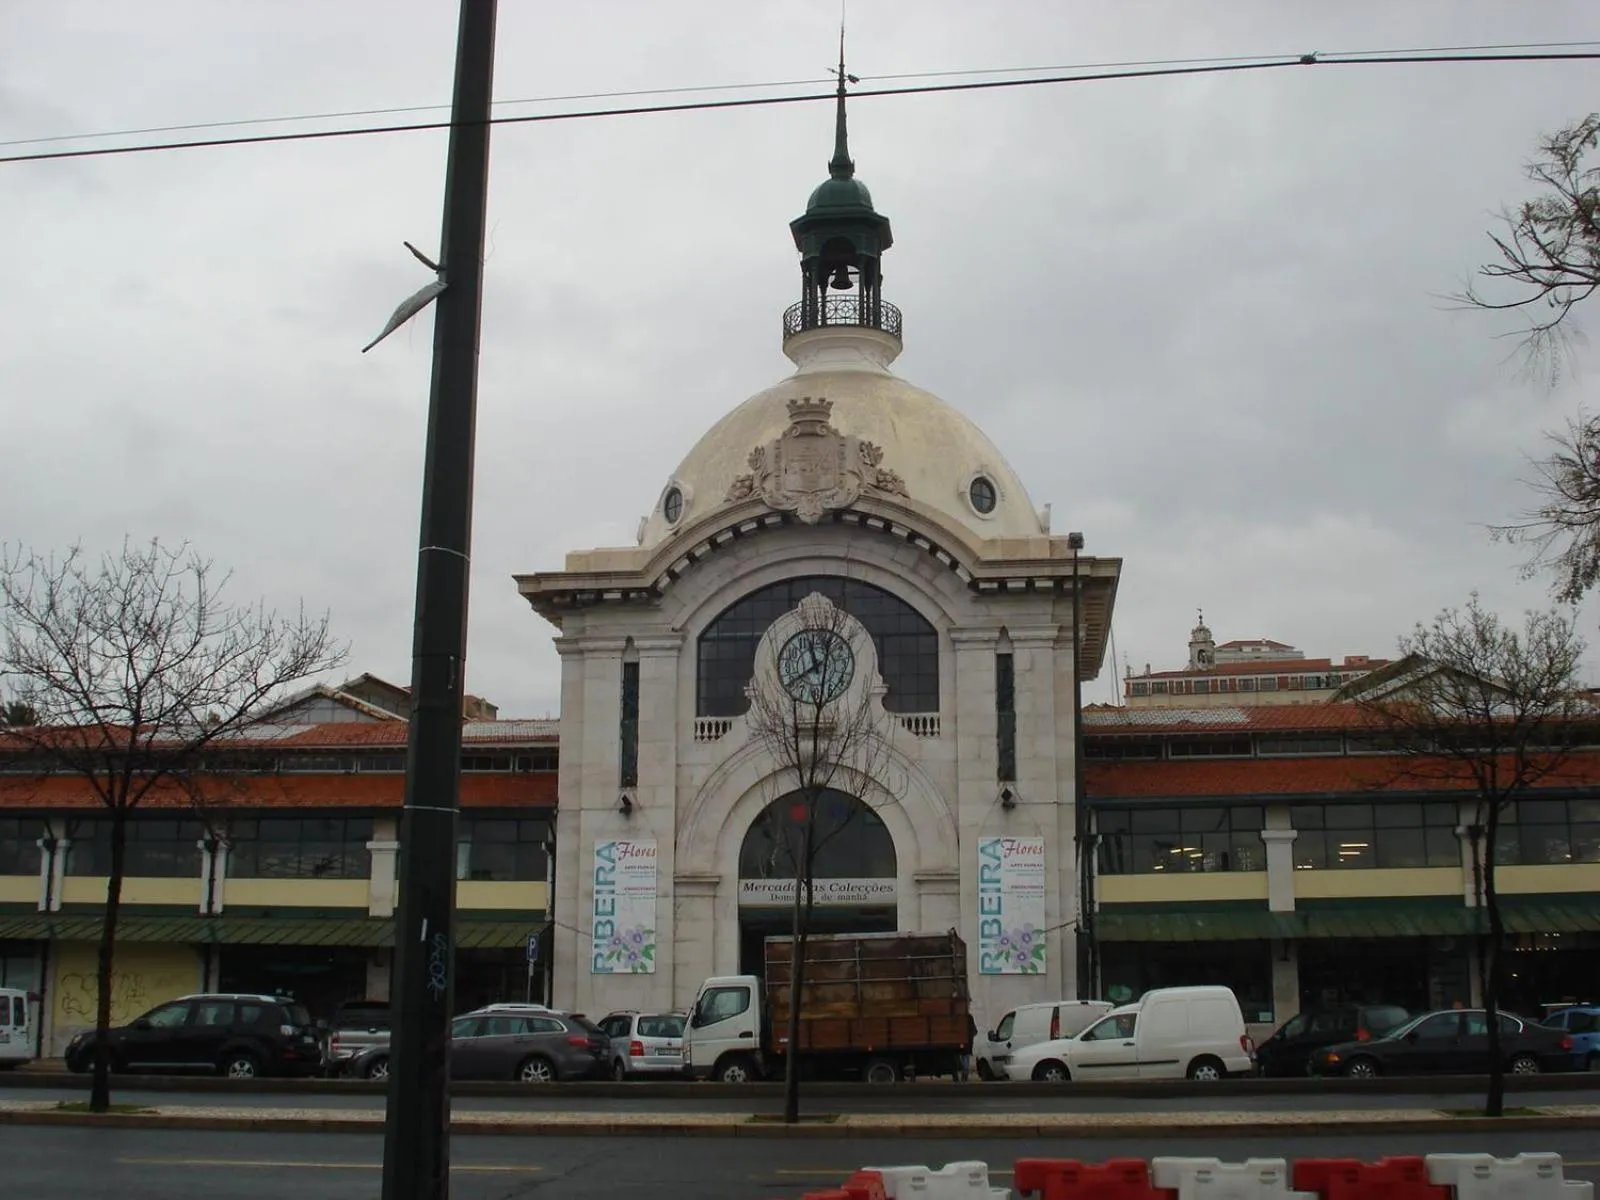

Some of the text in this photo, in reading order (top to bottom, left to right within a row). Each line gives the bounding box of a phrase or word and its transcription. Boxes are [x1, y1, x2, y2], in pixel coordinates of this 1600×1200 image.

[616, 841, 656, 861] Flores
[1001, 838, 1043, 859] Flores
[829, 881, 894, 895] Colecções
[529, 937, 536, 956] P
